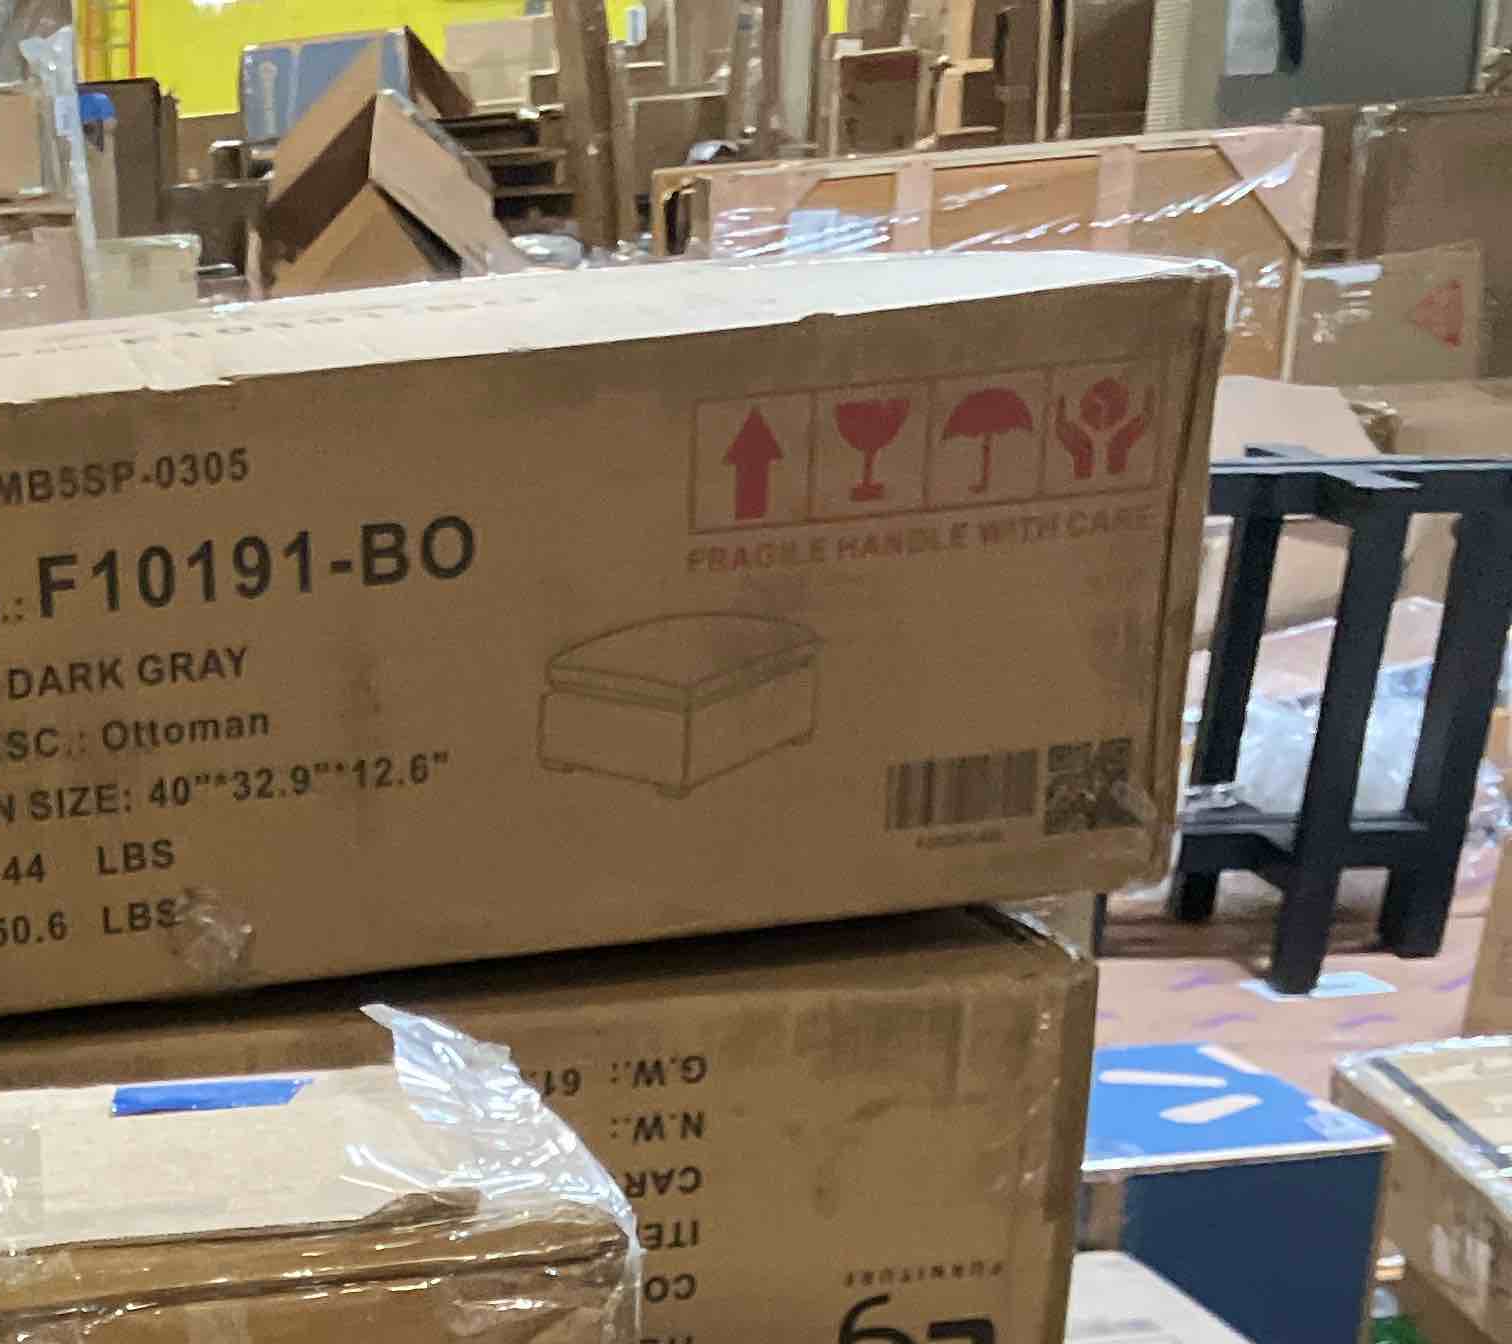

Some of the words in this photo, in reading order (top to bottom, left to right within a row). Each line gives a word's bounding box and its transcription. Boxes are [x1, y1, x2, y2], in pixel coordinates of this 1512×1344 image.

[687, 537, 827, 573] FRAGILE
[837, 521, 969, 561] HANDLE
[1063, 504, 1153, 537] CARE
[37, 515, 476, 619] F10191-BO
[6, 656, 126, 701] DARK
[136, 646, 248, 687] GRAY
[101, 711, 270, 753] Ottoman
[29, 781, 133, 823] SIZE:
[1, 852, 47, 886] 44
[96, 838, 175, 876] LBS
[101, 897, 177, 936] LBS
[638, 1219, 700, 1251] ITE
